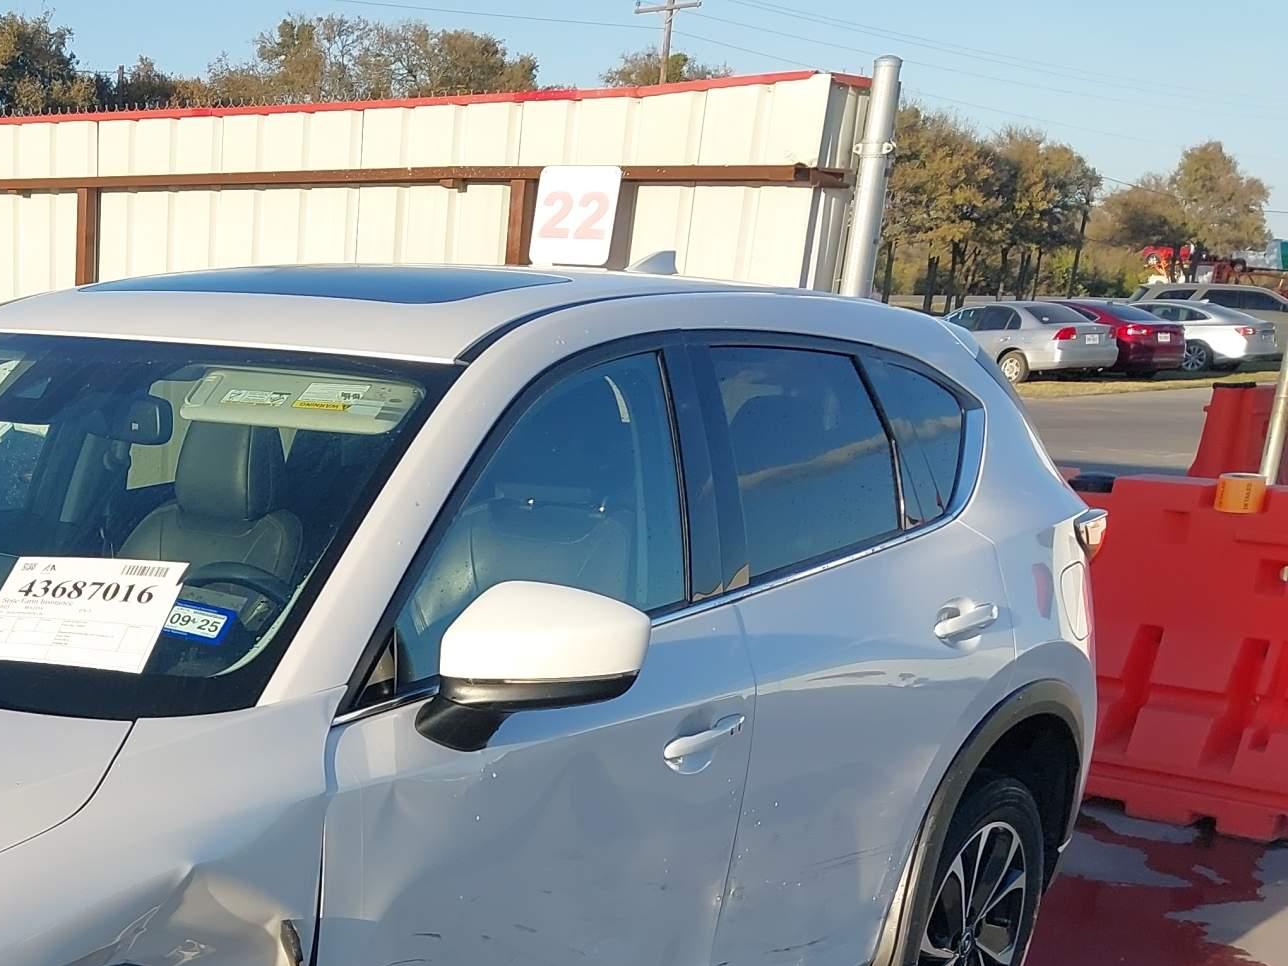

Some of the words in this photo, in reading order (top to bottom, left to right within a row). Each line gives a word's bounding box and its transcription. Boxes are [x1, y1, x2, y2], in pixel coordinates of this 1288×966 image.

[537, 191, 610, 240] 22
[18, 578, 159, 604] 43687016
[169, 612, 192, 627] 09
[196, 618, 221, 633] 25
